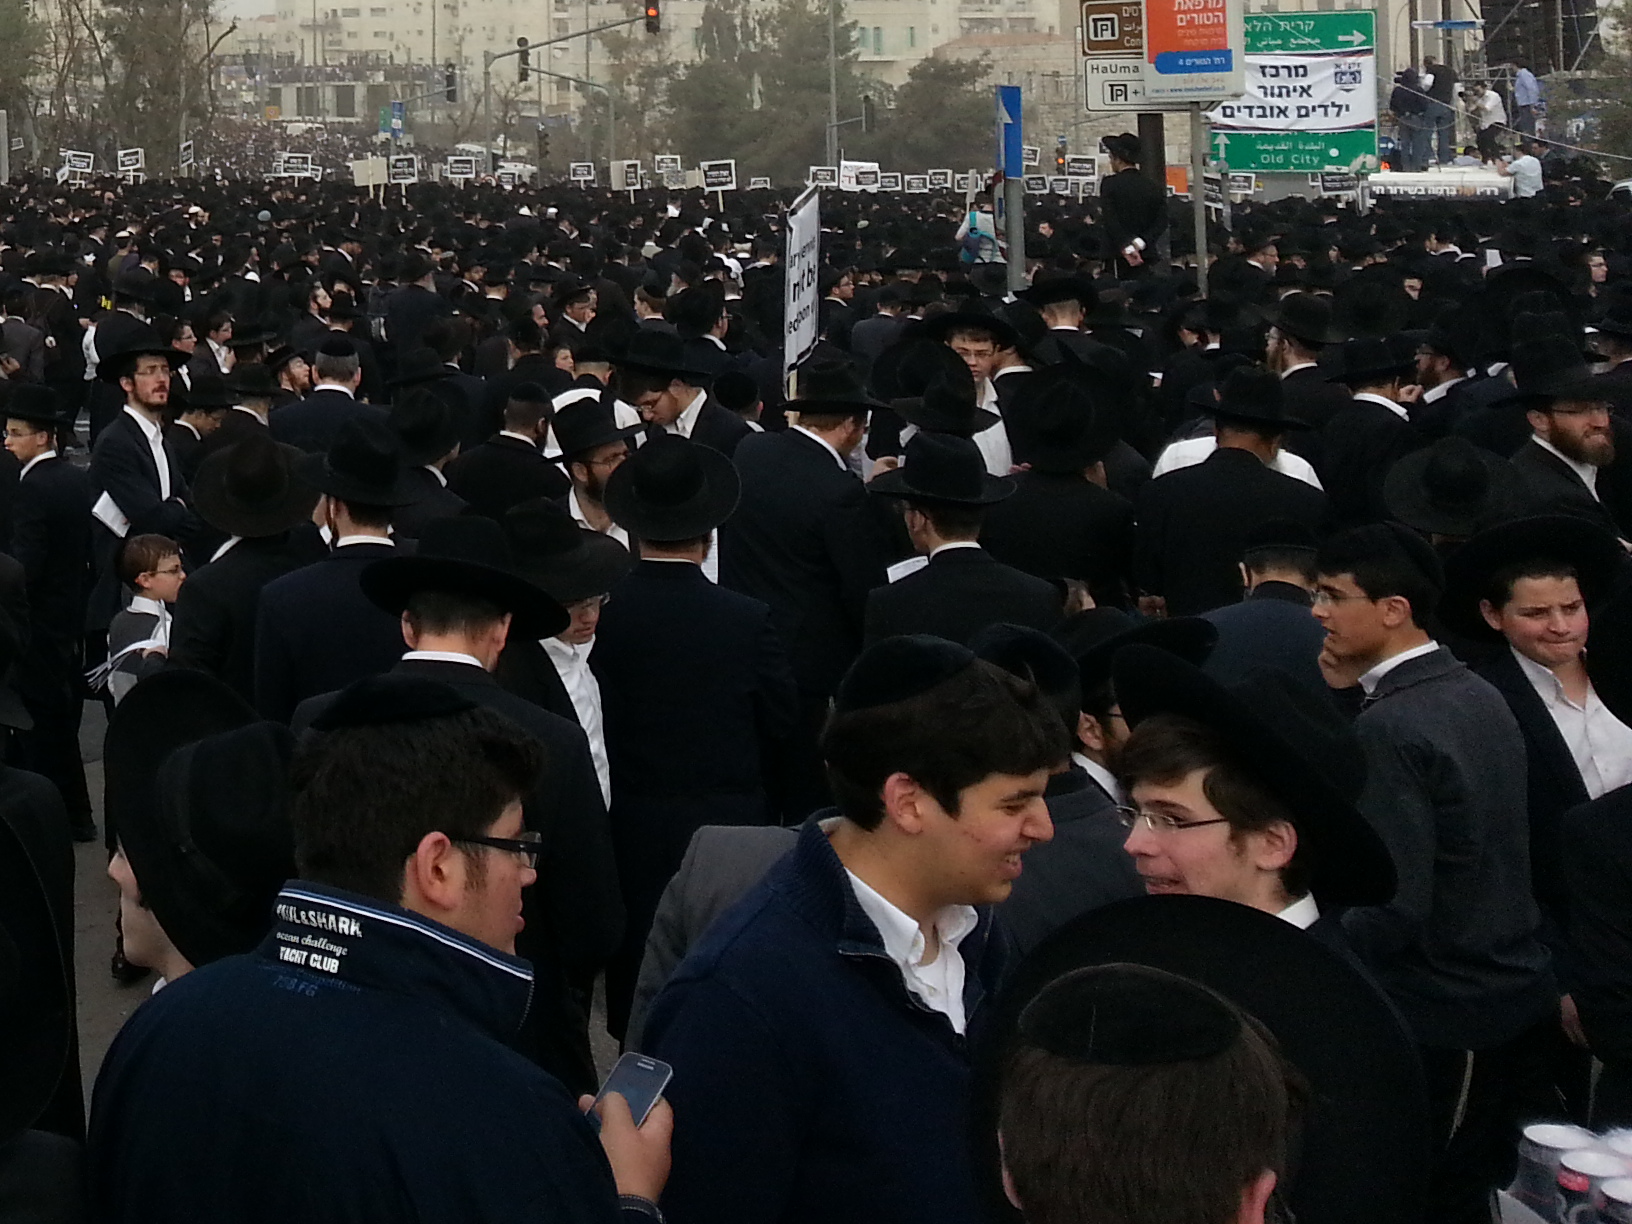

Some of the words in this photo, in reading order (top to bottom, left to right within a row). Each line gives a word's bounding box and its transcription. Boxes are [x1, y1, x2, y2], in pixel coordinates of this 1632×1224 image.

[1177, 12, 1224, 26] הטורים
[1090, 63, 1140, 74] HaUma
[1259, 64, 1308, 78] מרכז
[1257, 84, 1313, 98] איתור
[1221, 104, 1290, 119] אובדים
[1296, 101, 1350, 118] ילדים
[1260, 154, 1284, 164] Old
[1291, 154, 1320, 166] City
[1372, 186, 1385, 195] חי
[1387, 186, 1426, 195] בשידור
[276, 932, 300, 944] ocean
[301, 934, 348, 957] challenge
[279, 946, 308, 965] YACHT
[309, 953, 340, 974] CLUB
